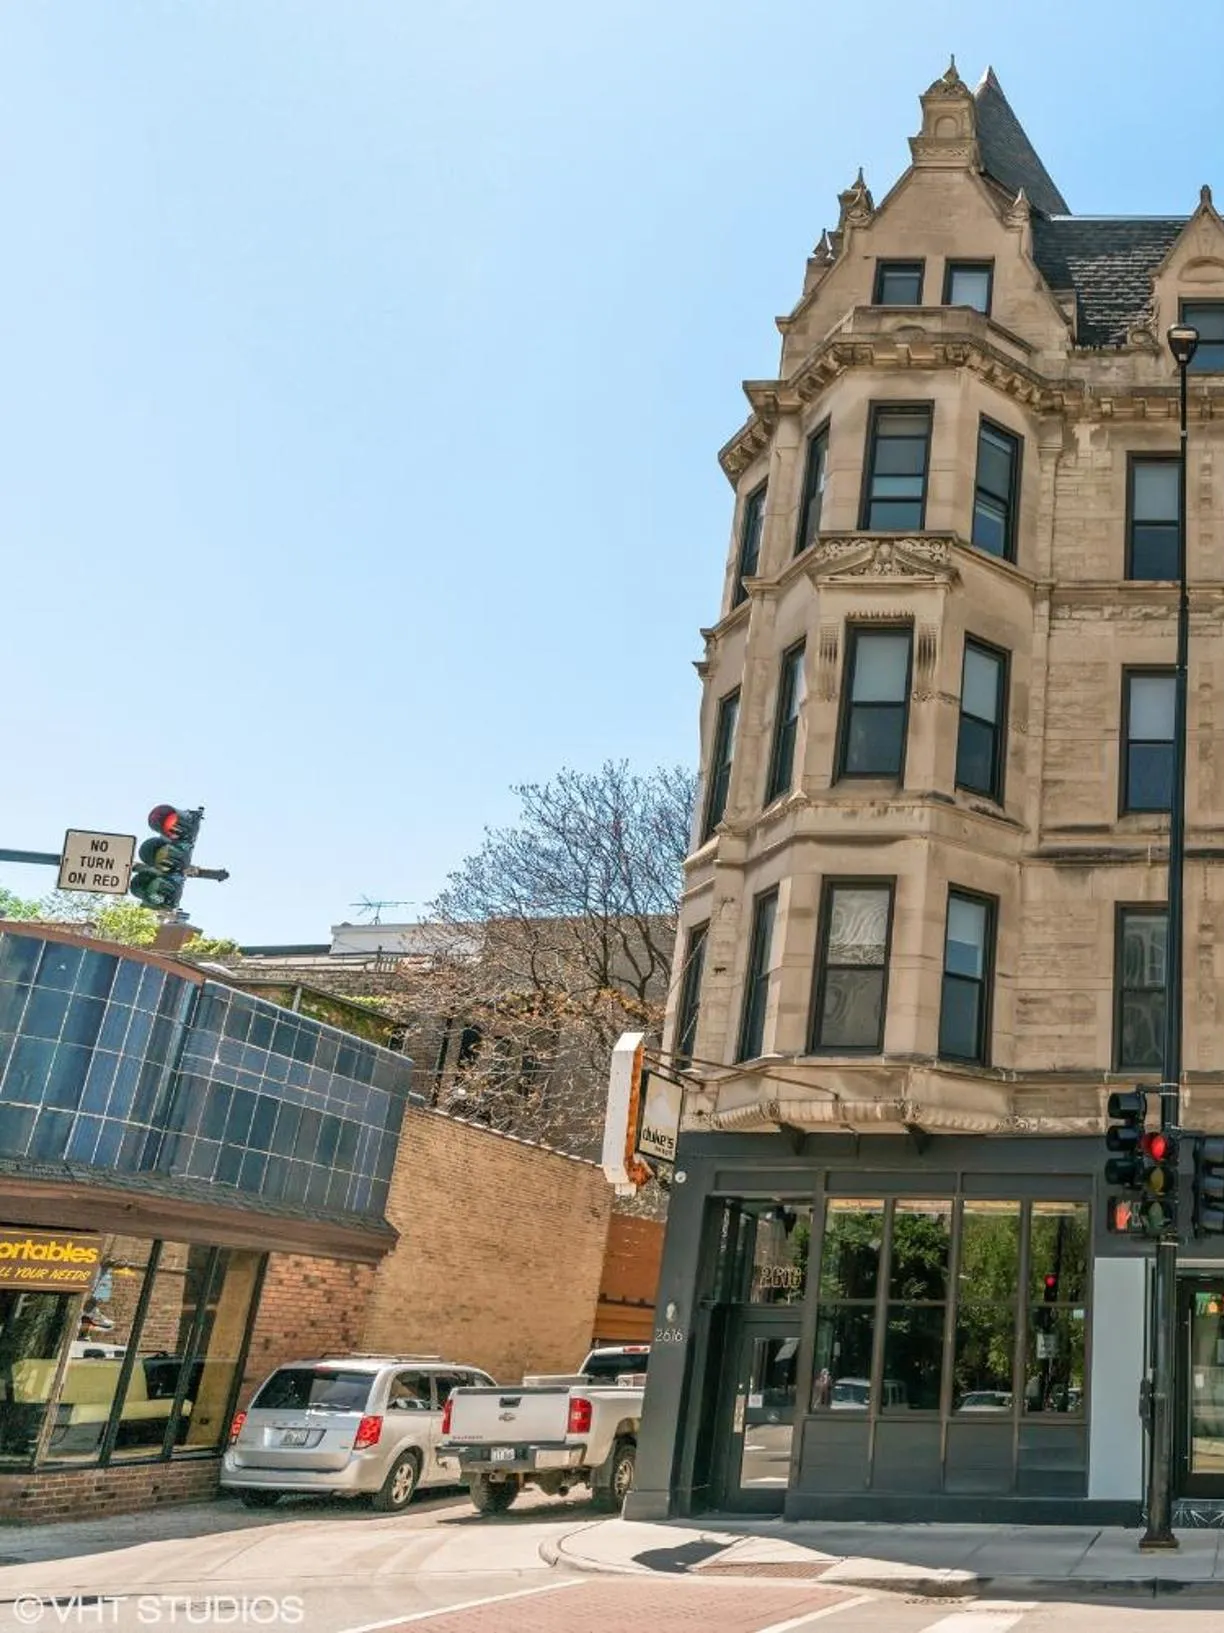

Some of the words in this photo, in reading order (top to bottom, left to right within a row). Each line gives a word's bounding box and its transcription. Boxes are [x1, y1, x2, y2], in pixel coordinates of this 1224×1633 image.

[91, 839, 109, 852] NO
[80, 856, 115, 870] TURN
[68, 872, 87, 885] ON
[92, 874, 120, 887] RED
[14, 1267, 49, 1279] YOUR
[49, 1269, 92, 1281] NEEDS
[655, 1328, 684, 1342] 2616
